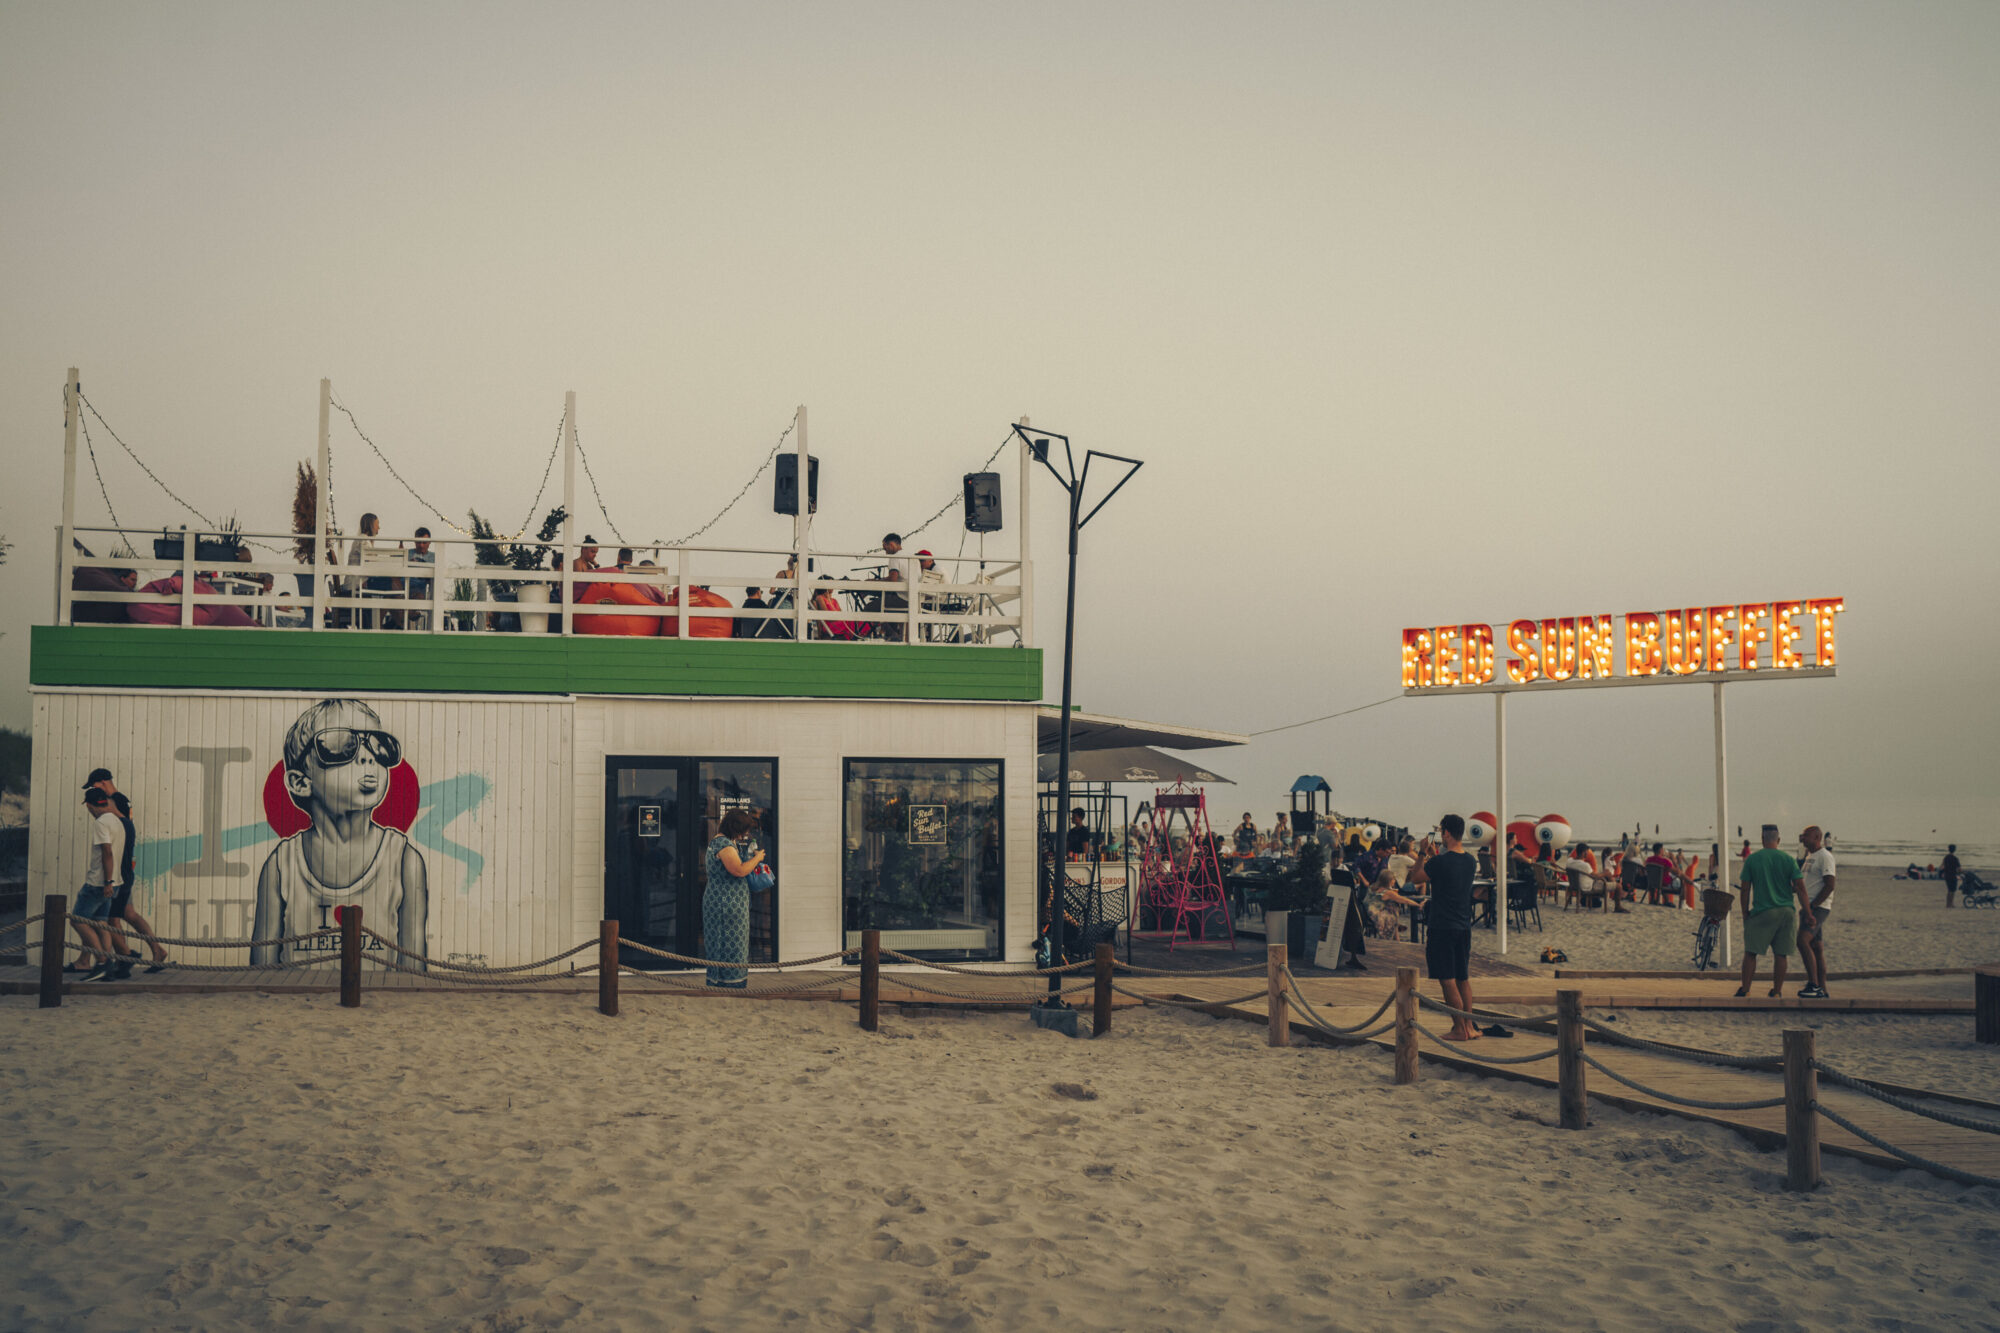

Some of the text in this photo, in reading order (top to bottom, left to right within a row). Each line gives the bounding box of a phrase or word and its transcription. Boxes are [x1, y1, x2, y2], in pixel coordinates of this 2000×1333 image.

[1401, 596, 1845, 688] RED SUN BUFFET
[173, 746, 252, 877] I
[917, 808, 933, 818] Red
[913, 818, 929, 827] Sun
[918, 821, 947, 834] Buffet
[318, 904, 332, 929] I
[293, 934, 384, 951] LIEPJA
